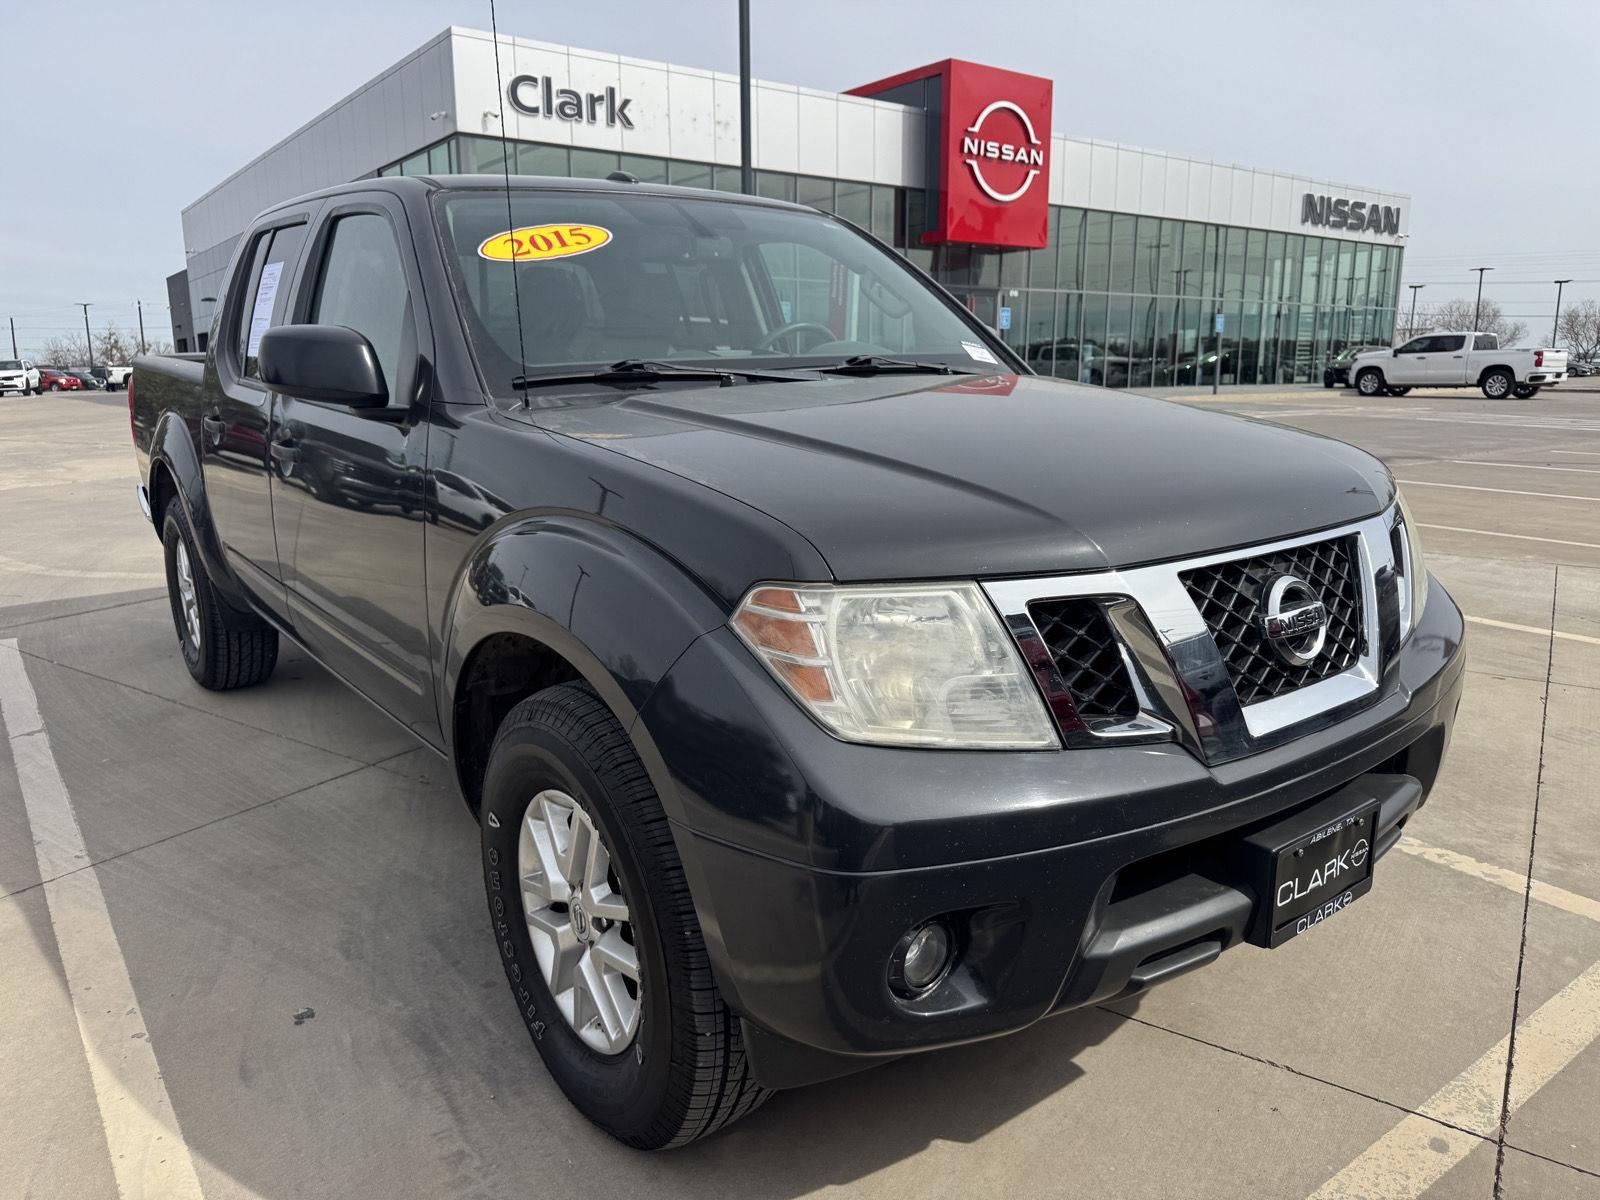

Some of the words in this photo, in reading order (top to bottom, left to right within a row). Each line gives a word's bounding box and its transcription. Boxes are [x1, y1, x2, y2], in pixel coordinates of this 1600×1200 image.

[507, 74, 635, 129] Clark
[963, 136, 1044, 166] NISSAN
[1301, 193, 1401, 236] NISSAN
[503, 227, 592, 257] 2015
[1278, 606, 1324, 635] NISSAN
[1345, 815, 1356, 827] TX
[1276, 848, 1351, 908] CLARK
[1296, 896, 1343, 935] CLARK
